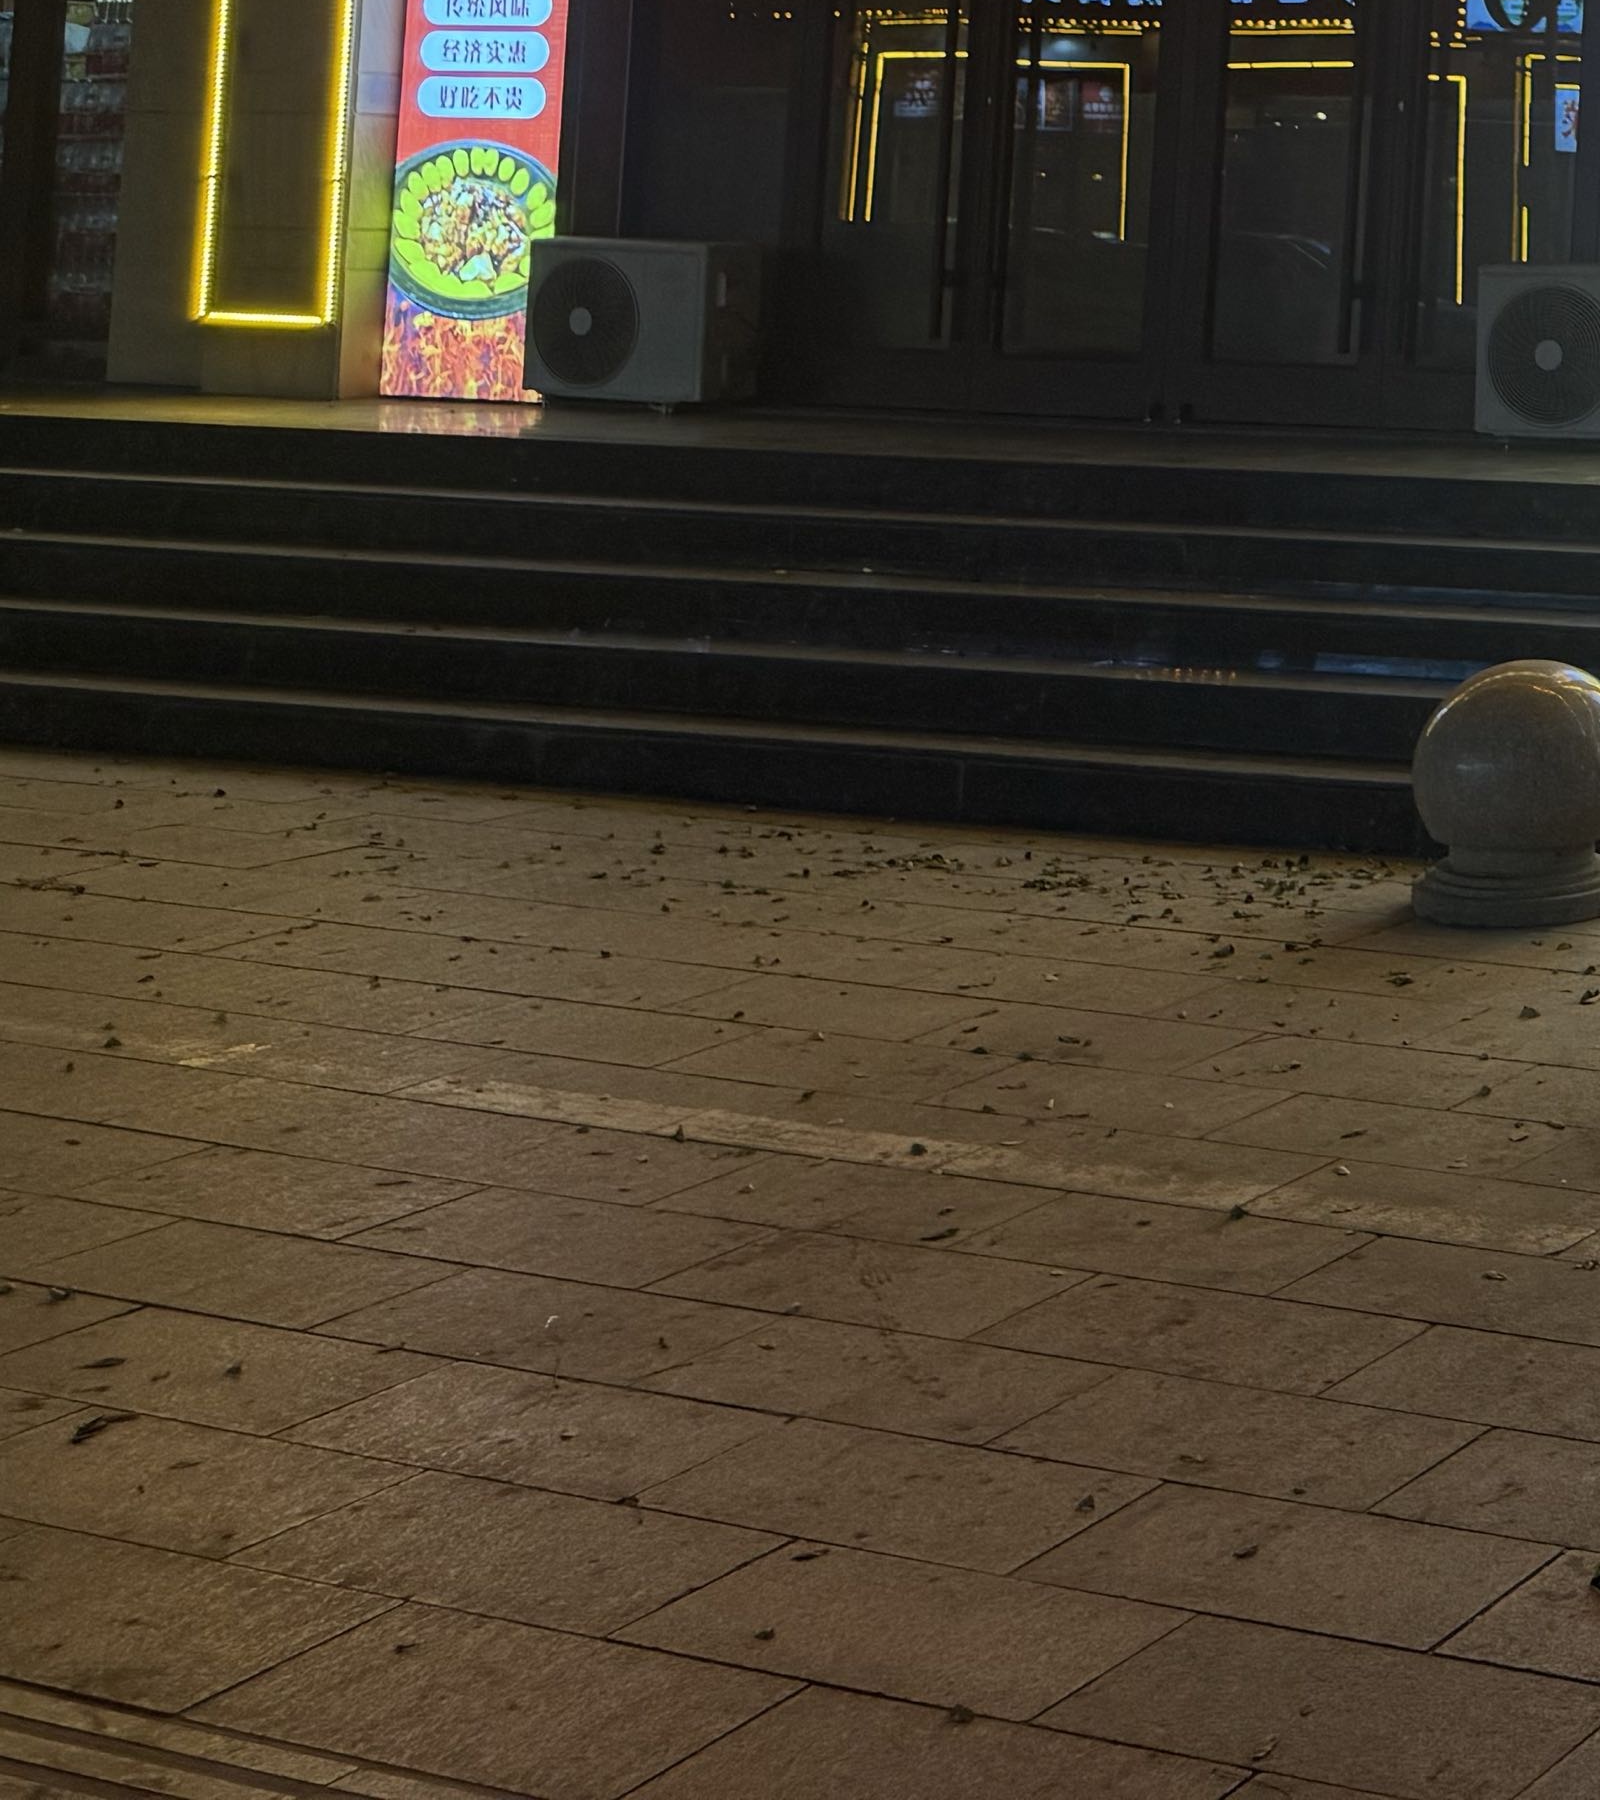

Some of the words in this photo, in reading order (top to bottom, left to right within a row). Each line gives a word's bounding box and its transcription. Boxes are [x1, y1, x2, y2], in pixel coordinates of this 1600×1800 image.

[442, 38, 528, 65] 经济实惠
[439, 84, 523, 112] 好吃不贵
